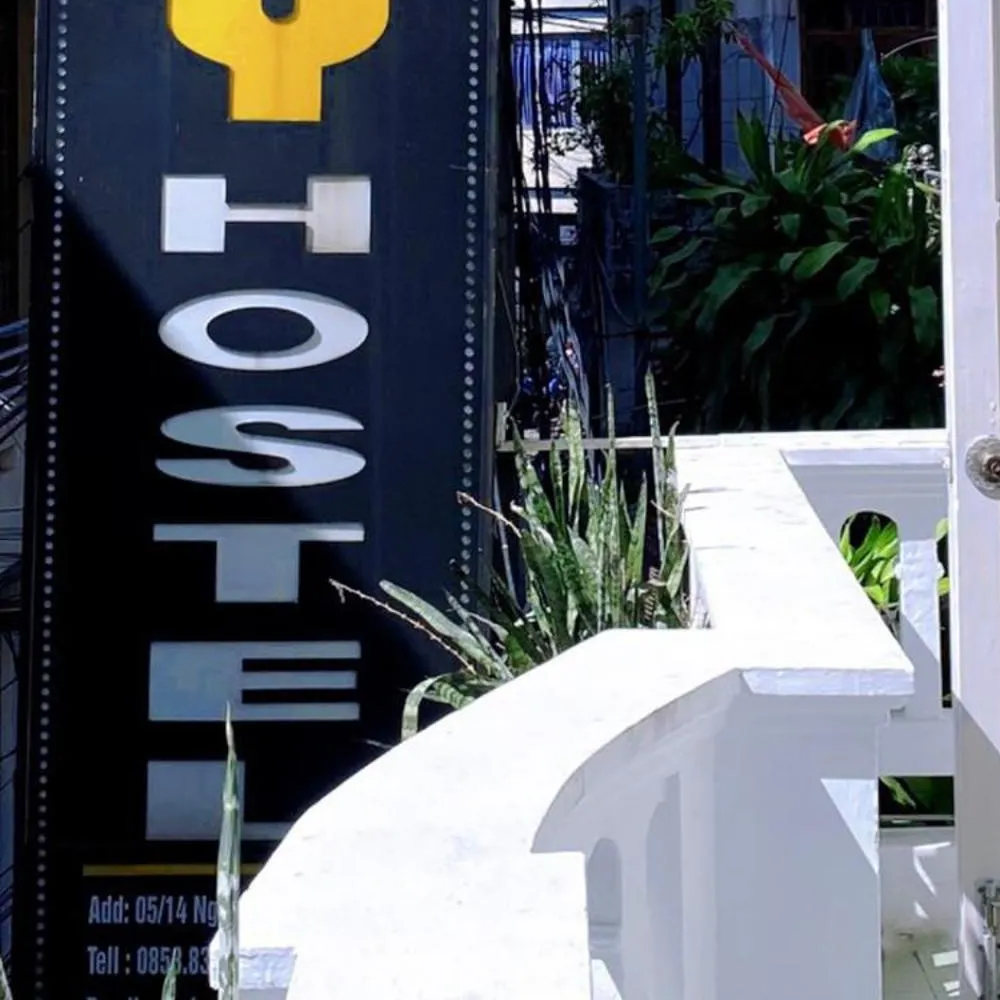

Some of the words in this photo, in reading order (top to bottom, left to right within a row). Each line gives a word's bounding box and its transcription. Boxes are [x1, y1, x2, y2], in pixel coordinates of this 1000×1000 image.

[146, 174, 372, 842] HOSTEL
[88, 895, 129, 924] Add:
[135, 895, 187, 924] 05/14
